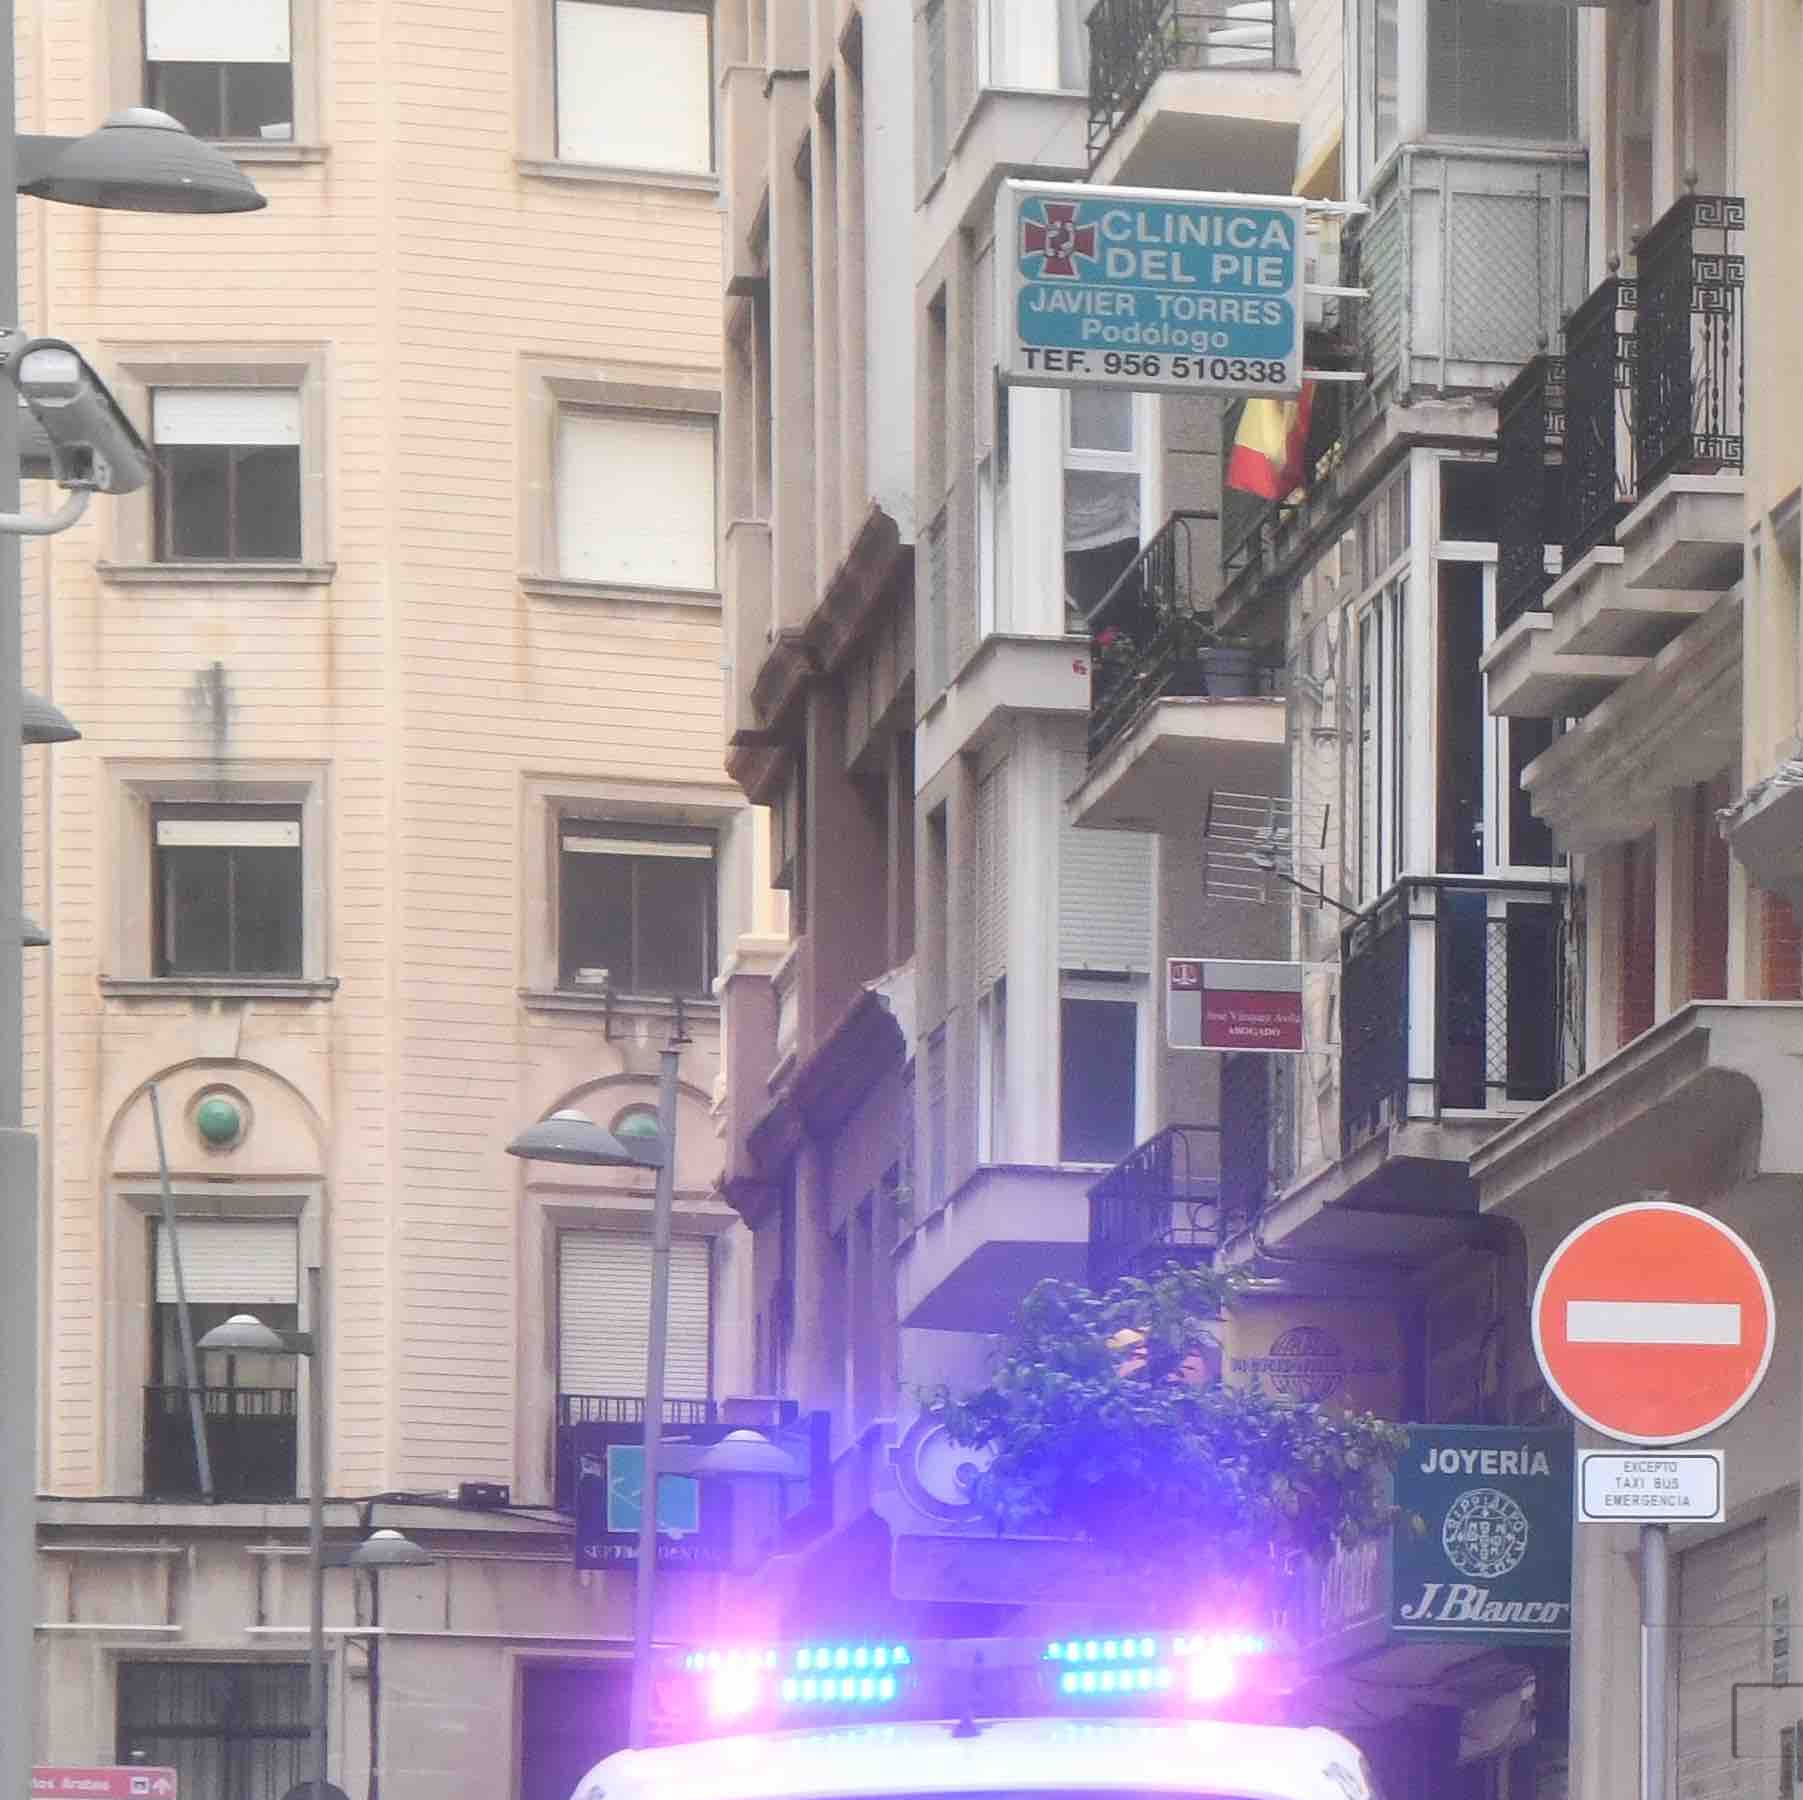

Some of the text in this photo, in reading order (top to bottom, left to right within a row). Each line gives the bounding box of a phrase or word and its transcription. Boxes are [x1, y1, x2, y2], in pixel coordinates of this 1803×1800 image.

[1101, 209, 1291, 250] CLINICA
[1105, 247, 1284, 288] DEL PIE
[1030, 289, 1282, 325] JAVIER TORRES
[1081, 319, 1229, 352] Podólogo
[1021, 348, 1287, 384] TEF. 956 510338
[1420, 1444, 1551, 1475] JOYERÍA
[1623, 1460, 1678, 1473] EXCEPTO
[1615, 1477, 1680, 1490] TAXI BUS
[1604, 1494, 1691, 1507] EMERGENCIA
